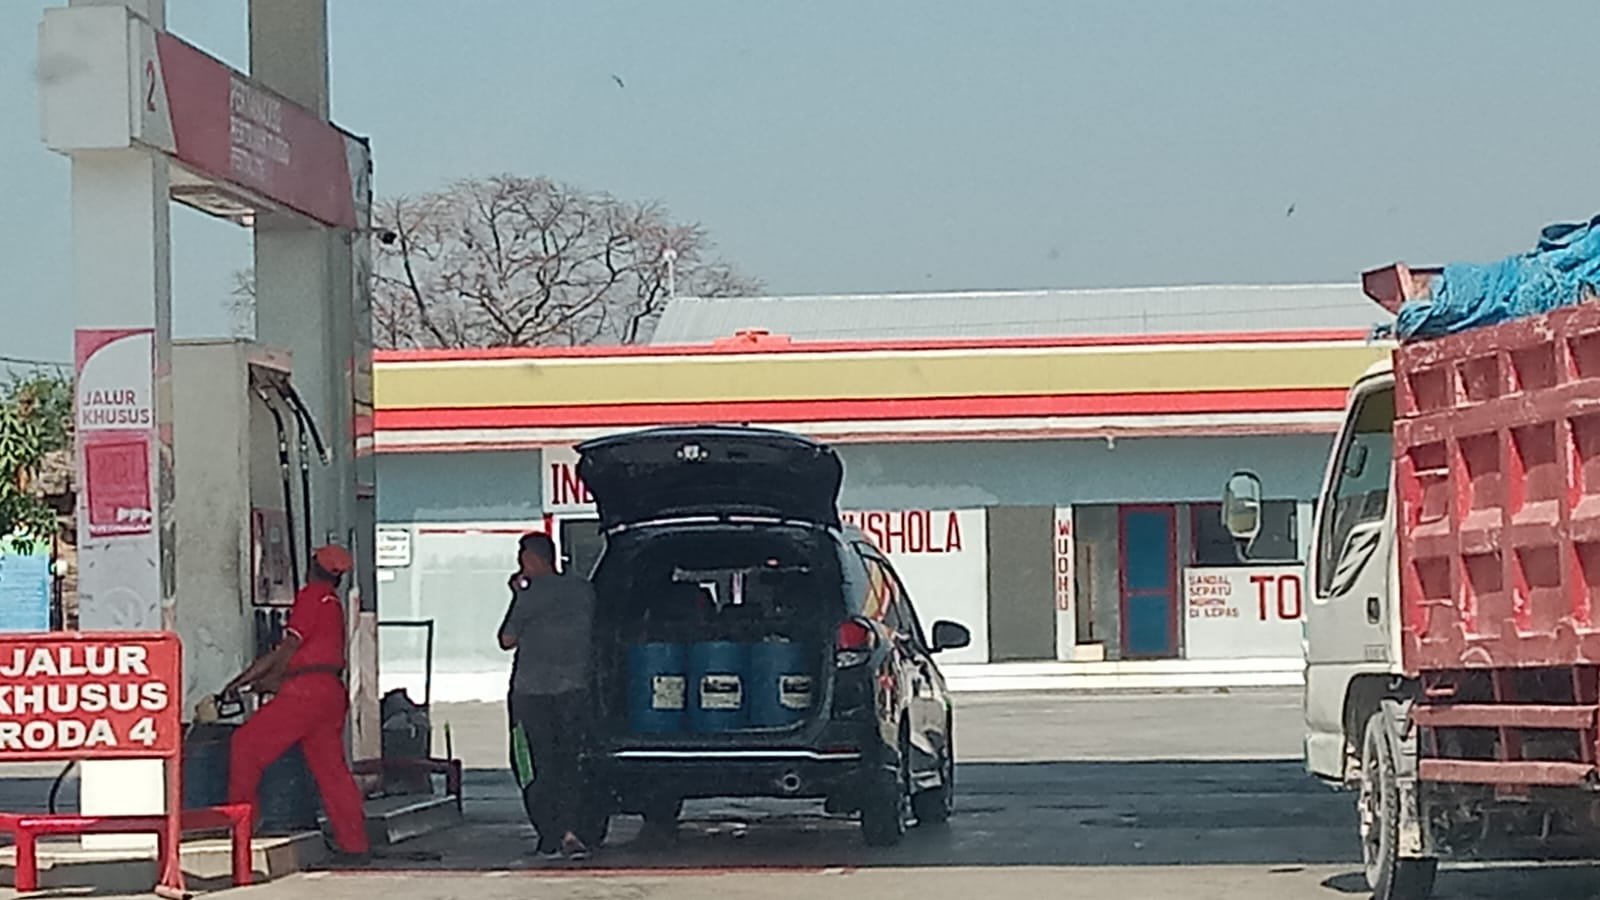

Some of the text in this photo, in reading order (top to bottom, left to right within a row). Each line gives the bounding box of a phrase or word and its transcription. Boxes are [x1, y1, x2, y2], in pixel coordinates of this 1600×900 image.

[146, 59, 156, 112] 2
[82, 389, 136, 406] JALUR
[82, 408, 150, 425] KHUSUS
[1189, 586, 1231, 596] SEPATU
[0, 646, 149, 676] JALUR
[0, 717, 157, 749] RODA 4
